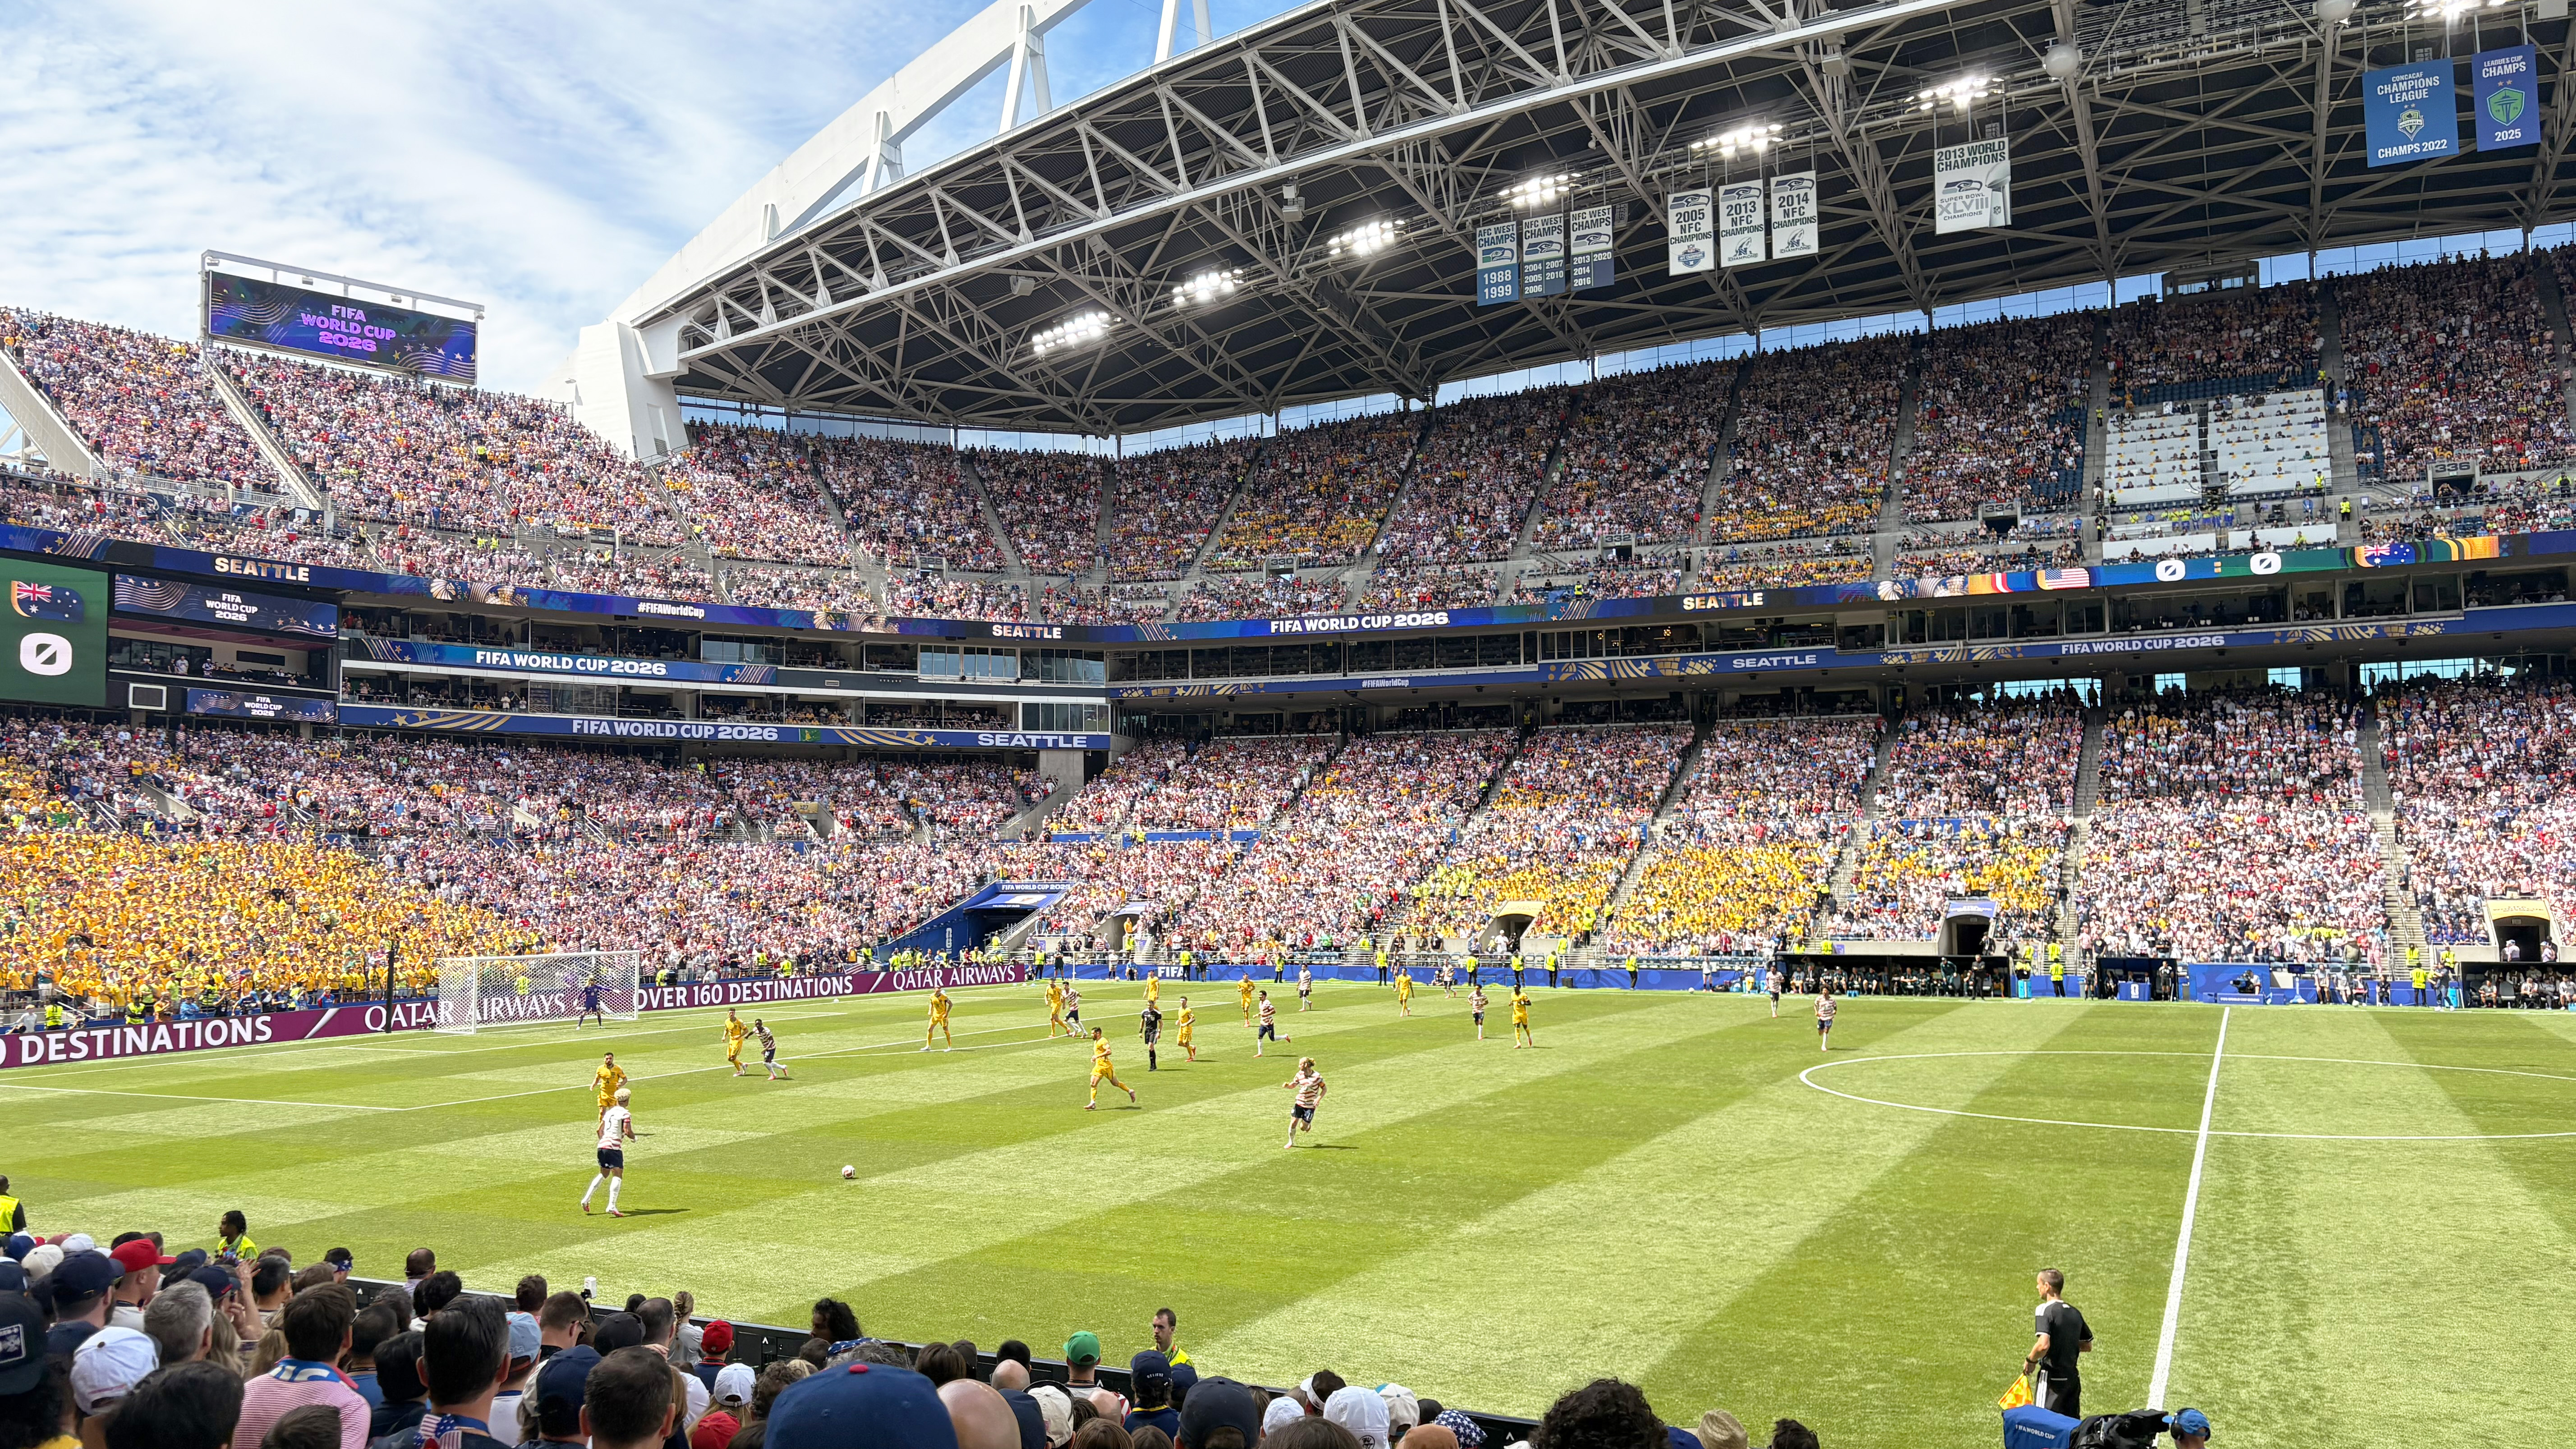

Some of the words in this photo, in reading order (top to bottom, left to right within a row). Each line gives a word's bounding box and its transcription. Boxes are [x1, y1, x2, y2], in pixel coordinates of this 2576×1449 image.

[2484, 57, 2510, 67] LEAGUES
[2511, 55, 2523, 63] CUP
[2392, 72, 2423, 82] CONCACAF
[2482, 61, 2526, 78] CHAMPS
[2377, 76, 2440, 96] CHAMPIONS
[2390, 88, 2429, 104] LEAGUE
[2494, 129, 2521, 142] 2025
[1937, 148, 1964, 162] 2013
[1967, 141, 2005, 156] WORLD
[2378, 143, 2420, 159] CHAMPS
[2422, 139, 2447, 152] 2022
[1937, 152, 2006, 172] CHAMPIONS
[1778, 192, 1809, 208] 2014
[1938, 197, 1988, 216] XLVIII
[1572, 212, 1587, 221] NFC
[1588, 207, 1611, 217] WEST
[1675, 208, 1705, 224] 2005
[1726, 201, 1757, 216] 2013
[1783, 206, 1805, 219] NFC
[1944, 211, 1983, 221] CHAMPIONS
[1524, 221, 1539, 229] NFC
[1541, 216, 1563, 226] WEST
[1572, 216, 1611, 232] CHAMPS
[1680, 221, 1701, 234] NFC
[1731, 214, 1753, 227] NFC
[1772, 215, 1817, 230] CHAMPIONS
[1478, 229, 1492, 238] AFC
[1494, 224, 1515, 234] WEST
[1524, 225, 1563, 240] CHAMPS
[1670, 231, 1712, 245] CHAMPIONS
[1720, 224, 1764, 238] CHAMPIONS
[1478, 233, 1515, 248] CHAMPS
[1524, 263, 1542, 272] 2004
[1546, 260, 1564, 269] 2007
[1573, 255, 1591, 265] 2013
[1593, 252, 1612, 261] 2020
[1484, 270, 1511, 285] 1988
[1524, 274, 1542, 283] 2005
[1546, 270, 1564, 280] 2010
[1573, 266, 1590, 276] 2014
[1524, 285, 1542, 294] 2006
[1573, 277, 1591, 287] 2016
[1484, 284, 1512, 299] 1999
[331, 304, 366, 322] FIFA
[301, 313, 362, 334] WORLD
[363, 325, 396, 341] CUP
[319, 331, 377, 352] 2026
[2435, 462, 2470, 473] 336
[1985, 503, 2015, 512] 334
[591, 528, 615, 537] 326
[1605, 534, 1631, 543] 332
[215, 557, 309, 582] SEATTLE
[222, 593, 242, 603] FIFA
[1683, 592, 1763, 611] SEATTLE
[206, 600, 239, 612] WORLD
[239, 605, 258, 614] CUP
[637, 602, 705, 619] #FIFAWorldCup
[215, 611, 248, 622] 2026
[1271, 618, 1302, 634] FIFA
[1304, 616, 1359, 632] WORLD
[1362, 614, 1392, 629] CUP
[1394, 612, 1449, 626] 2026
[993, 624, 1062, 639] SEATTLE
[2061, 642, 2093, 655] FIFA
[2094, 640, 2142, 653] WORLD
[2144, 637, 2172, 649] CUP
[2174, 635, 2225, 648] 2026
[476, 651, 511, 666] FIFA
[513, 654, 574, 670] WORLD
[576, 658, 608, 672] CUP
[611, 660, 667, 675] 2026
[1732, 654, 1817, 669] SEATTLE
[1362, 678, 1409, 688] #FIFAWorldCup
[244, 702, 268, 710] WORLD
[573, 719, 611, 735] FIFA
[614, 721, 677, 737] WORLD
[679, 723, 713, 739] CUP
[717, 727, 779, 741] 2026
[978, 733, 1088, 747] SEATTLE
[893, 970, 943, 991] QATAR
[950, 965, 1016, 986] AIRWAYS
[1158, 966, 1186, 977] FIFA
[638, 986, 688, 1009] OVER
[694, 983, 722, 1005] 160
[728, 975, 853, 1003] DESTINATIONS
[364, 999, 452, 1031] QATAR
[469, 992, 565, 1024] AIRWAYS
[19, 1015, 272, 1064] DESTINATIONS
[2027, 1427, 2044, 1437] WORLD
